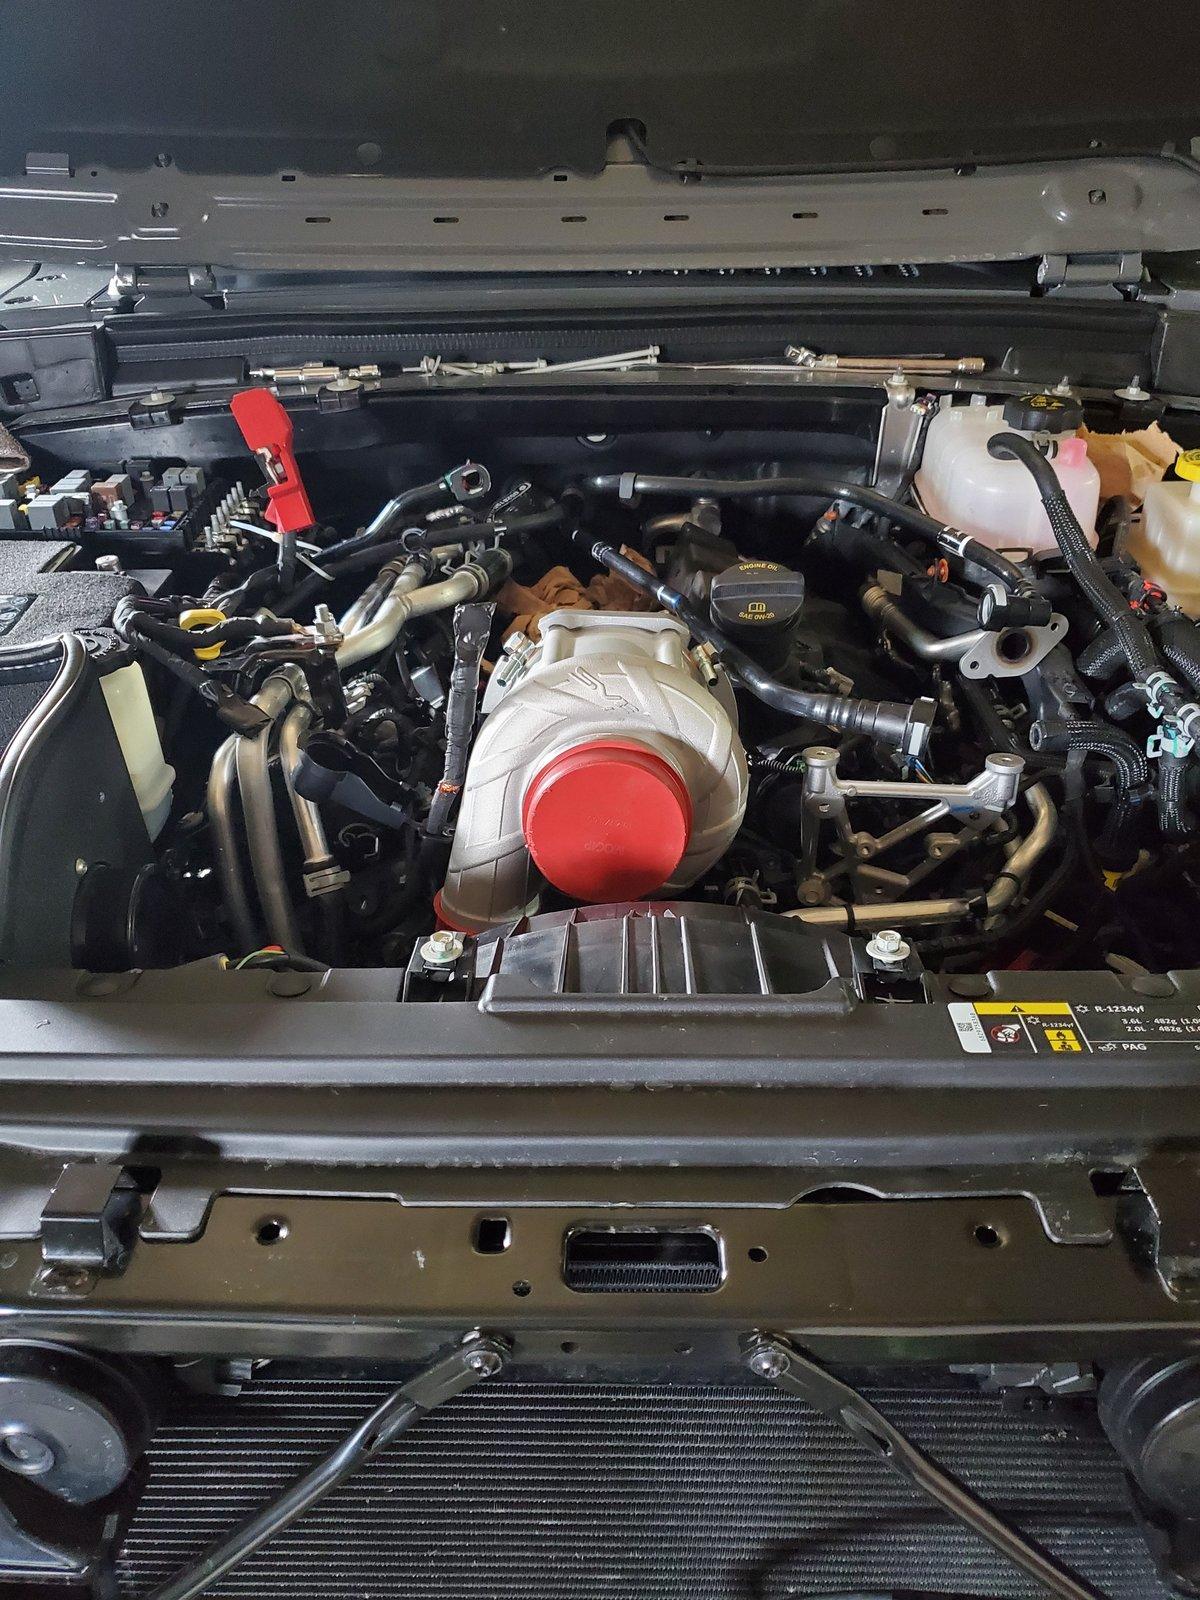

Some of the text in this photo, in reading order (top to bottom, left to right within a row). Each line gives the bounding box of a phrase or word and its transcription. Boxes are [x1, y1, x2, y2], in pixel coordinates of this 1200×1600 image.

[739, 563, 766, 571] ENGINE
[738, 612, 753, 620] SAE
[1094, 1005, 1145, 1013] R-1234yf
[1122, 1043, 1147, 1051] PAG
